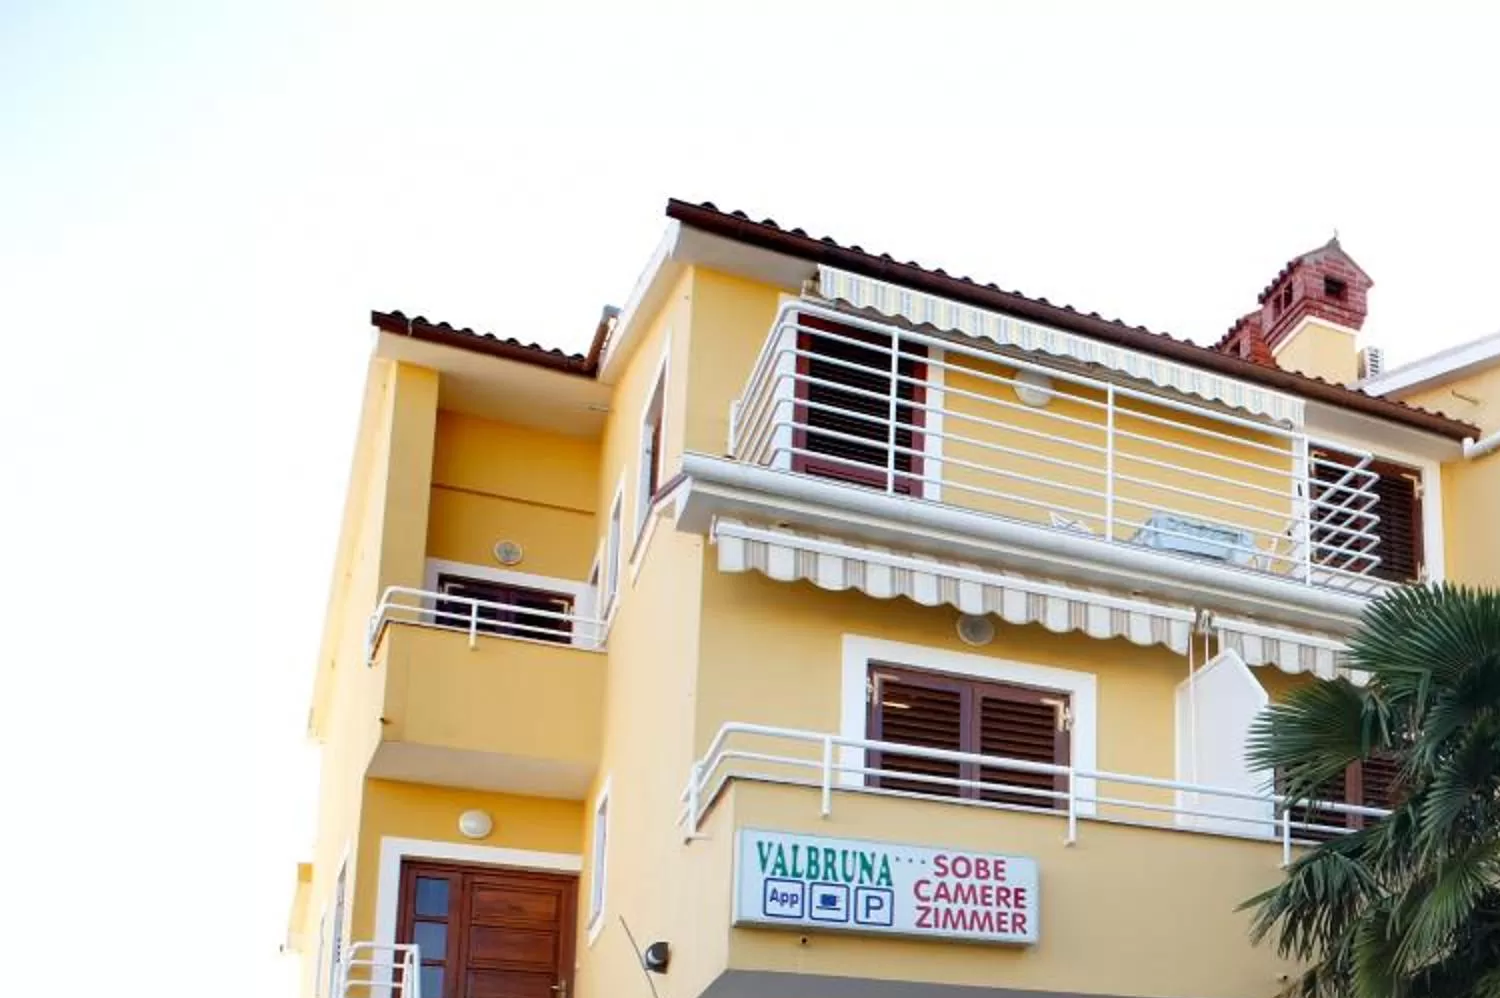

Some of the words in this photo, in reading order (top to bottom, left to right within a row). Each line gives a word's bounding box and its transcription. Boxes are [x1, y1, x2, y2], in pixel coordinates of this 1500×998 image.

[756, 840, 894, 887] VALBRUNA
[933, 854, 1006, 881] SOBE
[769, 887, 800, 907] App
[865, 895, 884, 919] P
[913, 880, 1028, 910] CAMERE
[915, 906, 1028, 935] ZIMMER
